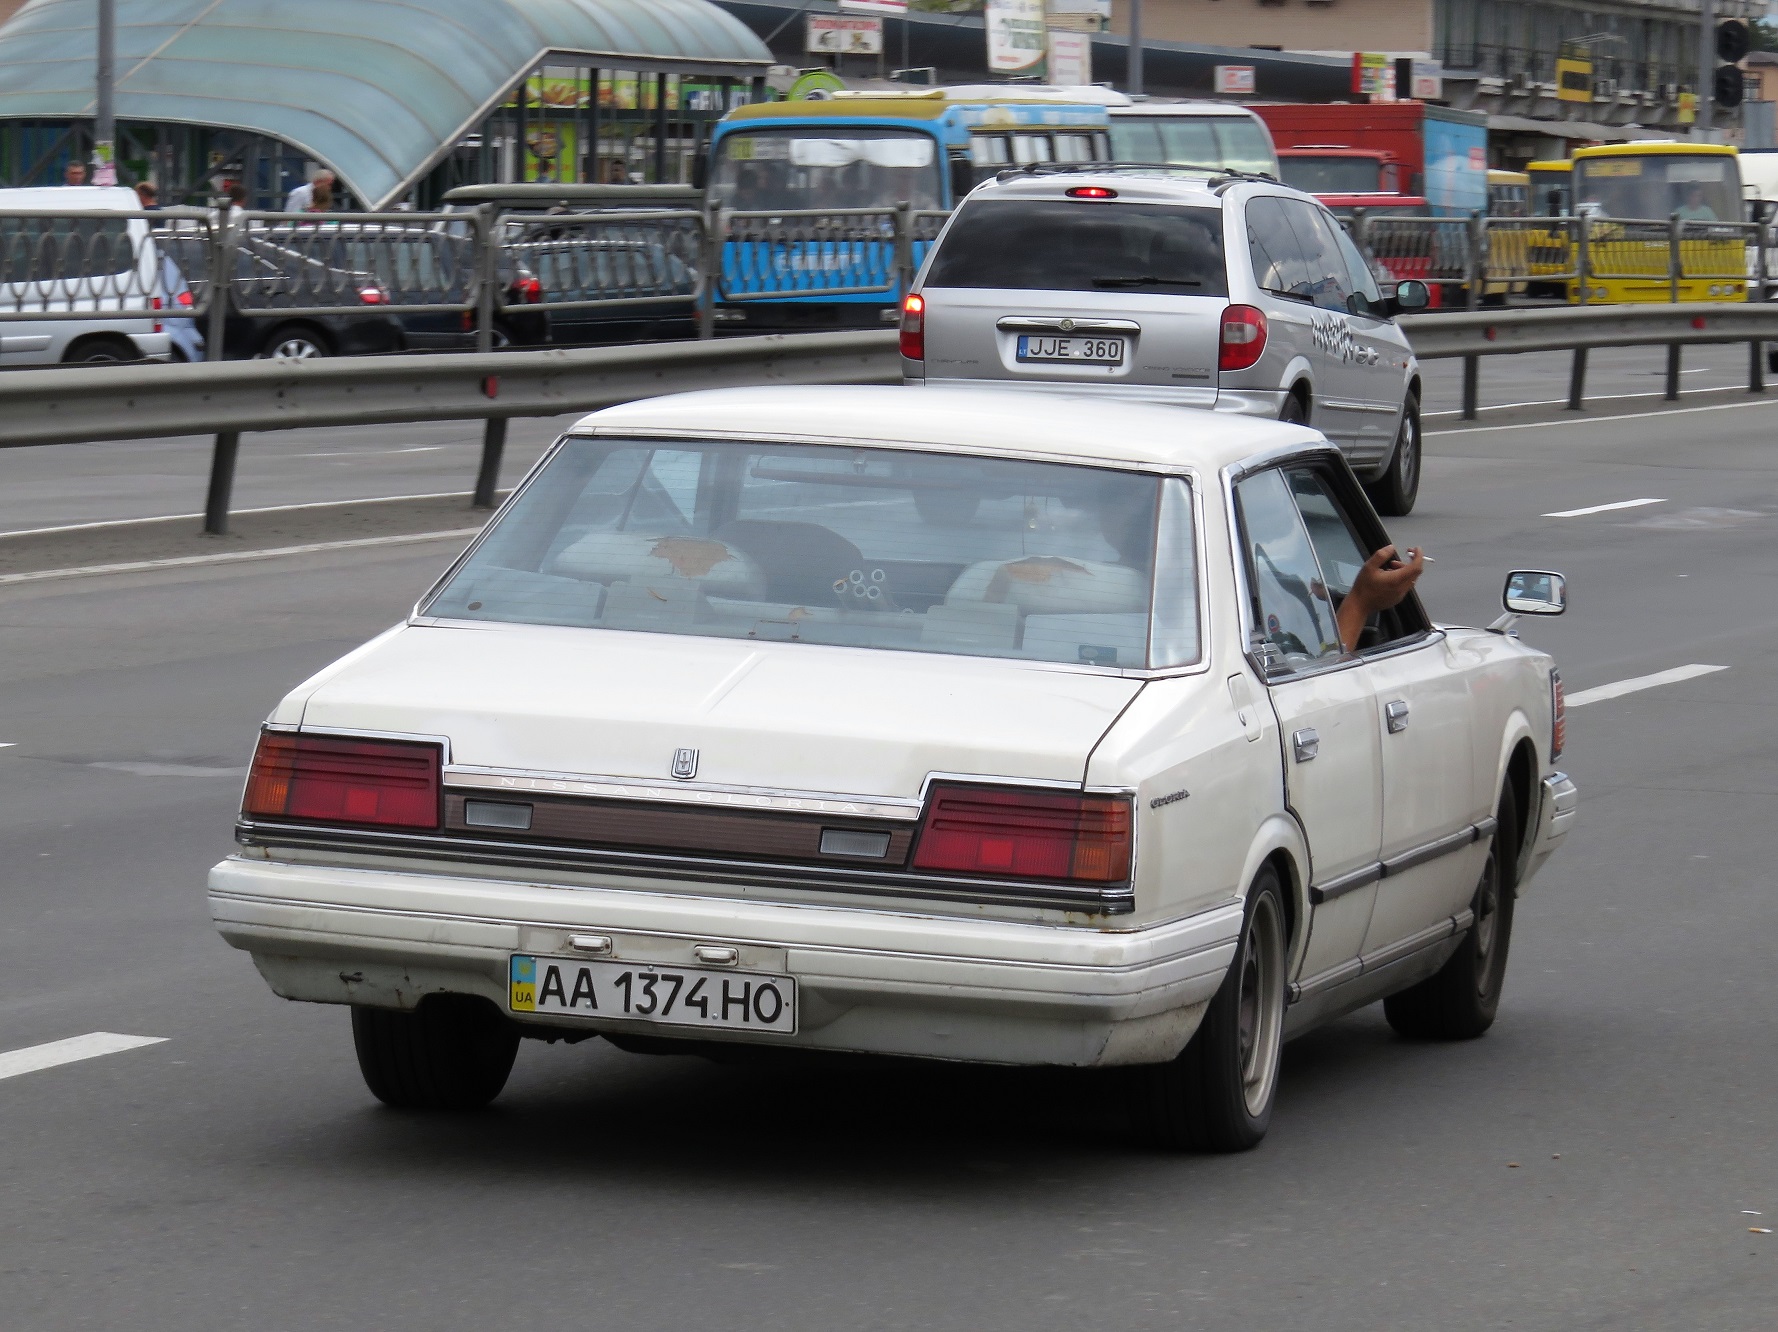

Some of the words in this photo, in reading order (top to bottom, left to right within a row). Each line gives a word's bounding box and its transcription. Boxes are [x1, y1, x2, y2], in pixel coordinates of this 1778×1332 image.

[1030, 339, 1071, 357] JJE
[1083, 340, 1119, 359] 360
[500, 777, 662, 797] NISSAN
[696, 793, 860, 813] GLORIA
[515, 991, 533, 1004] UA
[538, 964, 599, 1010] AA
